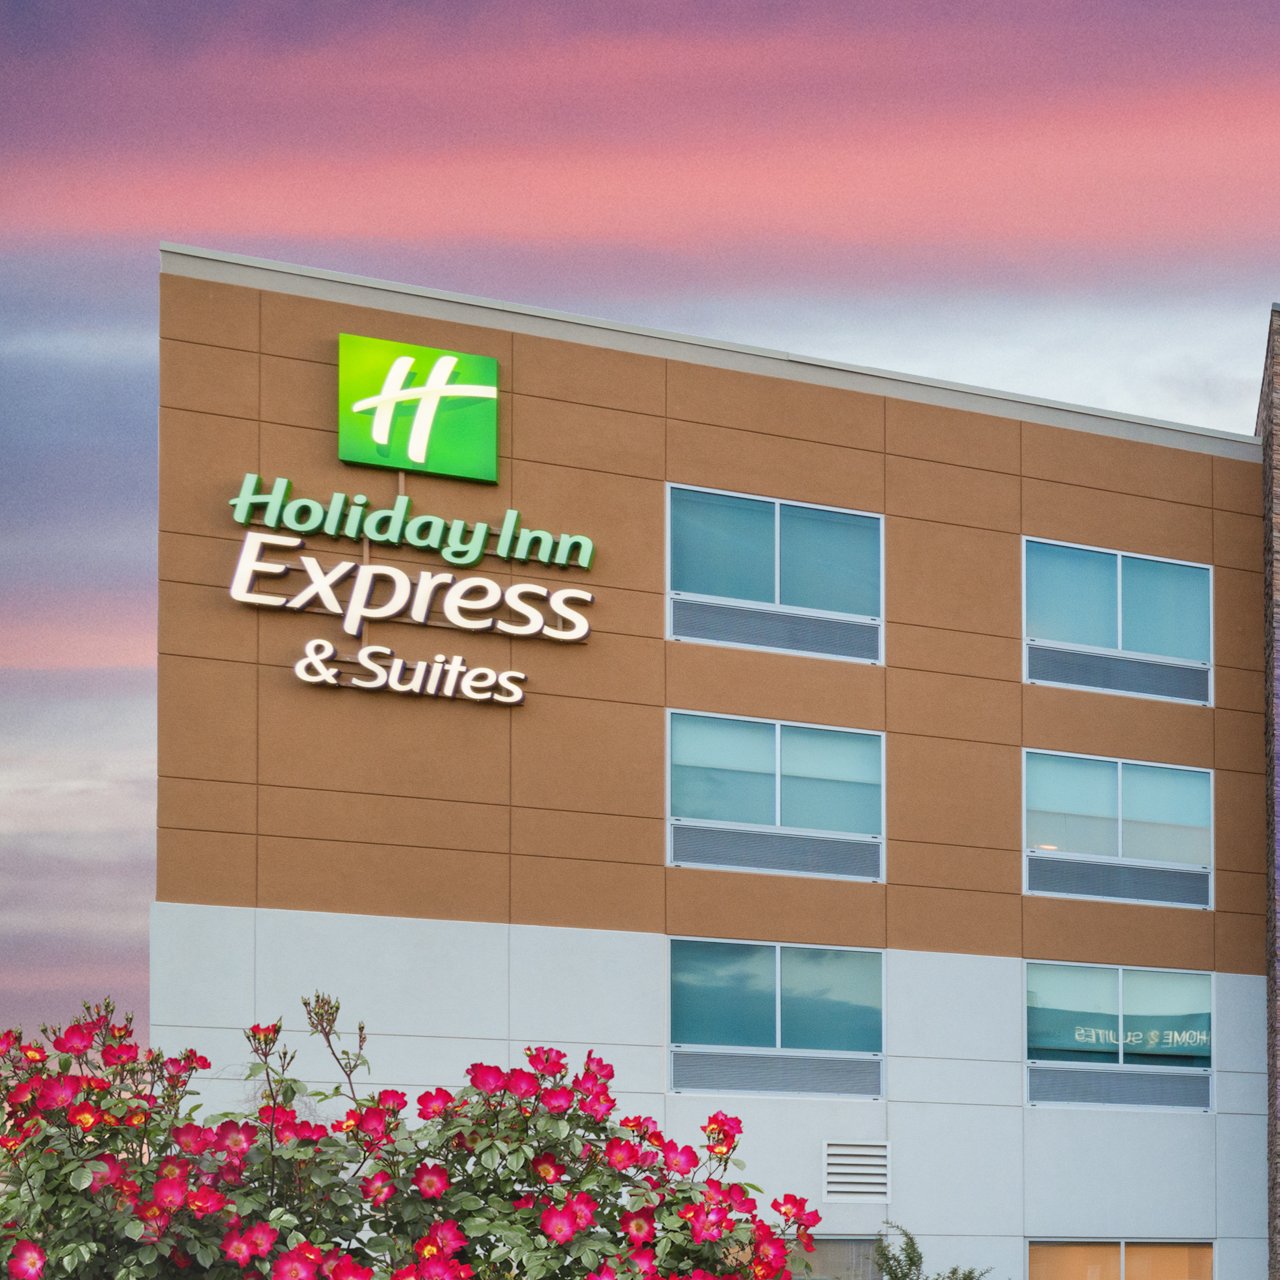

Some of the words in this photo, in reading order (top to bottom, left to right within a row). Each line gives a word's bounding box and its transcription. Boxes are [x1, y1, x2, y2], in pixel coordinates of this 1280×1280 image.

[228, 472, 489, 568] Holiday
[497, 508, 597, 571] Inn
[229, 531, 596, 643] Express
[294, 638, 340, 686] &
[351, 644, 528, 705] Suites
